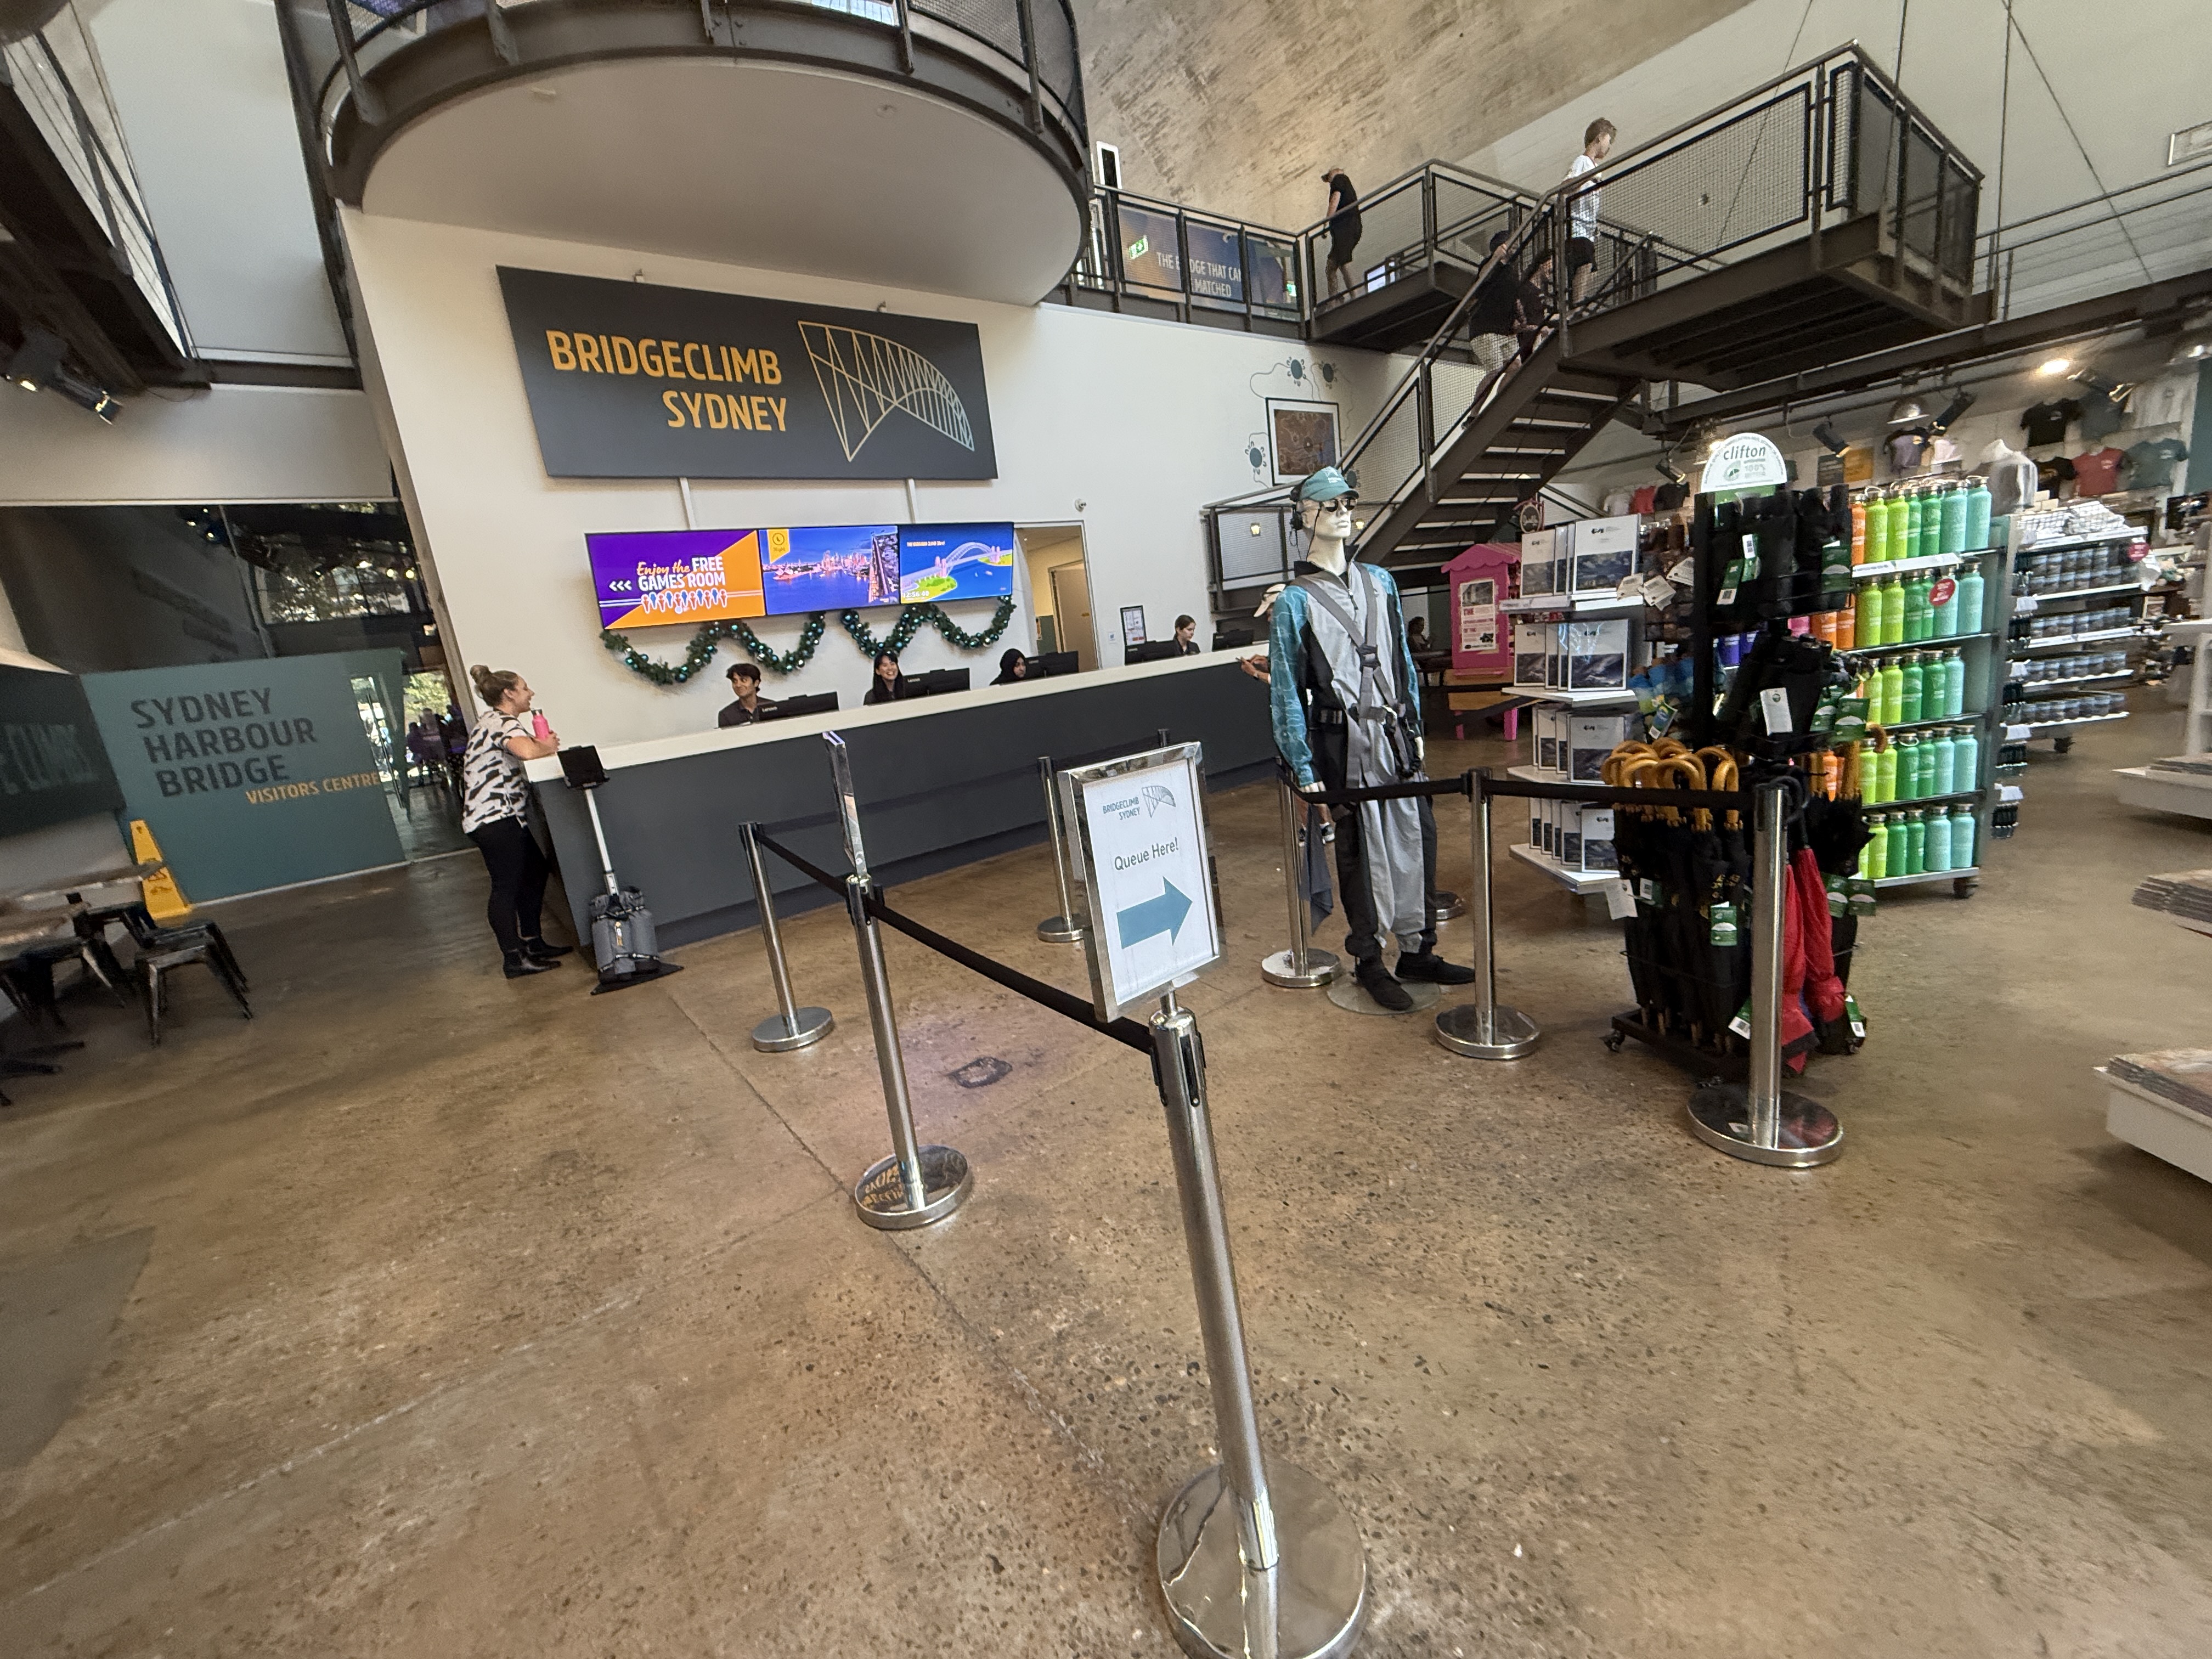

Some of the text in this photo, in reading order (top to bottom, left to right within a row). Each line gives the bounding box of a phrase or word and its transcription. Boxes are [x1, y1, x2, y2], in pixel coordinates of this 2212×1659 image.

[1156, 252, 1174, 269] THE
[1176, 256, 1206, 275] BDGE
[1206, 262, 1227, 279] THAT
[1194, 278, 1232, 298] MATCHED
[546, 330, 782, 385] BRIDGECLIMB
[663, 390, 787, 432] SYDNEY
[1724, 445, 1766, 460] clifton
[637, 556, 724, 576] Enjoy the FREE
[638, 571, 726, 591] GAMES ROOM
[131, 687, 270, 729] SYDNEY
[144, 718, 317, 763] HARBOUR
[156, 755, 290, 797] BRIDGE
[246, 770, 381, 804] VISITORS CENTRE
[1103, 797, 1139, 814] BRIDGECLIMB
[1119, 806, 1140, 820] SYDNEY
[1114, 837, 1179, 871] Queue Here!
